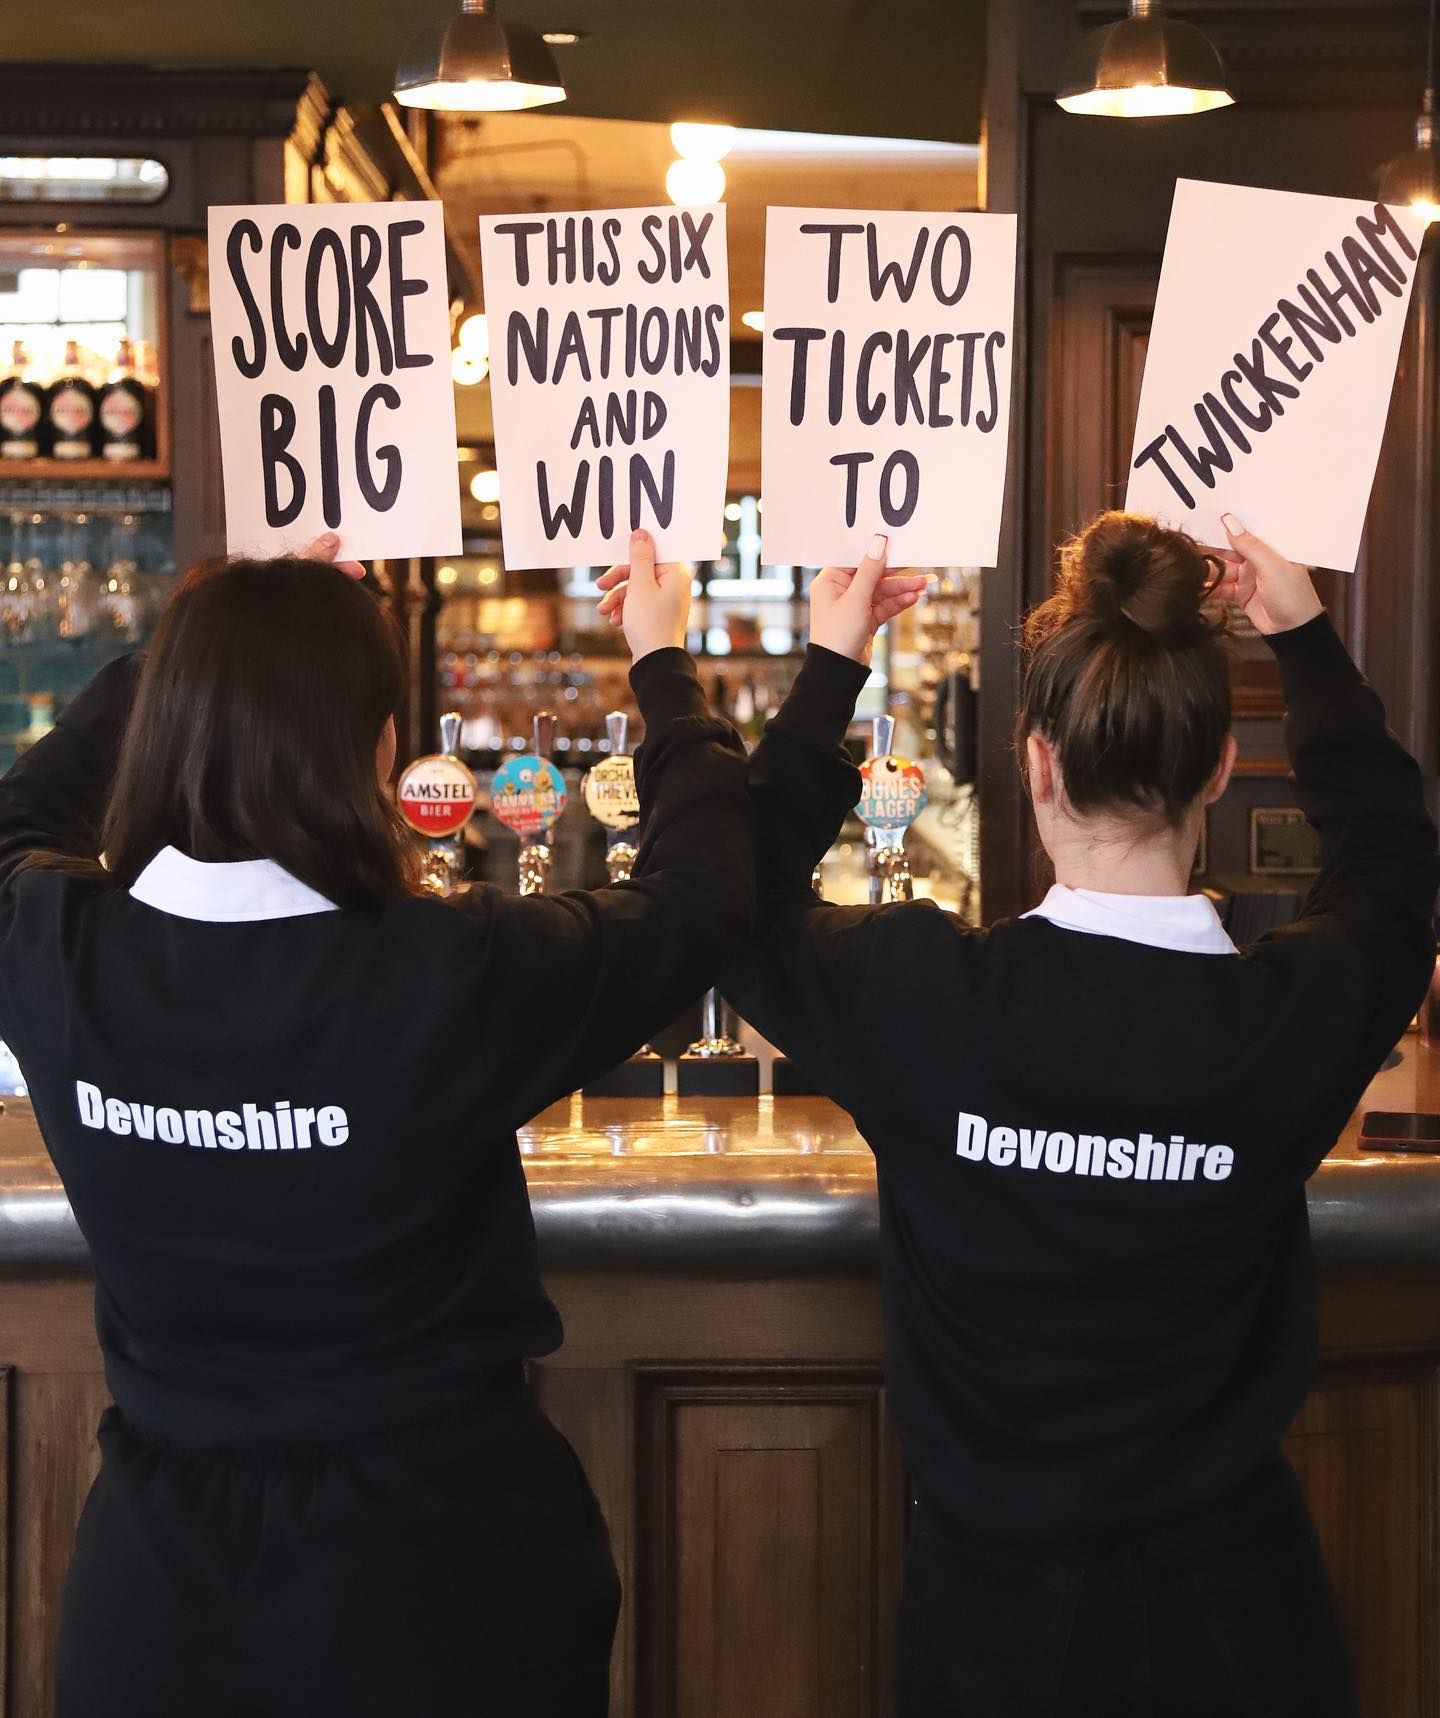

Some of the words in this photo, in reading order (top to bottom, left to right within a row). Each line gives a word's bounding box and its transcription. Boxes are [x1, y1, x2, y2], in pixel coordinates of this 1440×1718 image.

[494, 216, 622, 287] THIS
[637, 211, 714, 285] SIX
[799, 222, 972, 307] TWO
[226, 218, 434, 380] SCORE
[506, 303, 725, 387] NATIONS
[772, 327, 1006, 434] TICKETS
[1133, 201, 1418, 511] TWICKENHAM
[259, 383, 403, 530] BIG
[570, 389, 668, 450] AND
[536, 449, 675, 541] WIN
[829, 449, 920, 529] TO
[404, 783, 470, 799] AMSTEL
[420, 804, 451, 817] BIER
[863, 799, 916, 818] LAGER
[76, 1080, 350, 1152] Devonshire
[956, 1111, 1235, 1182] Devonshire
